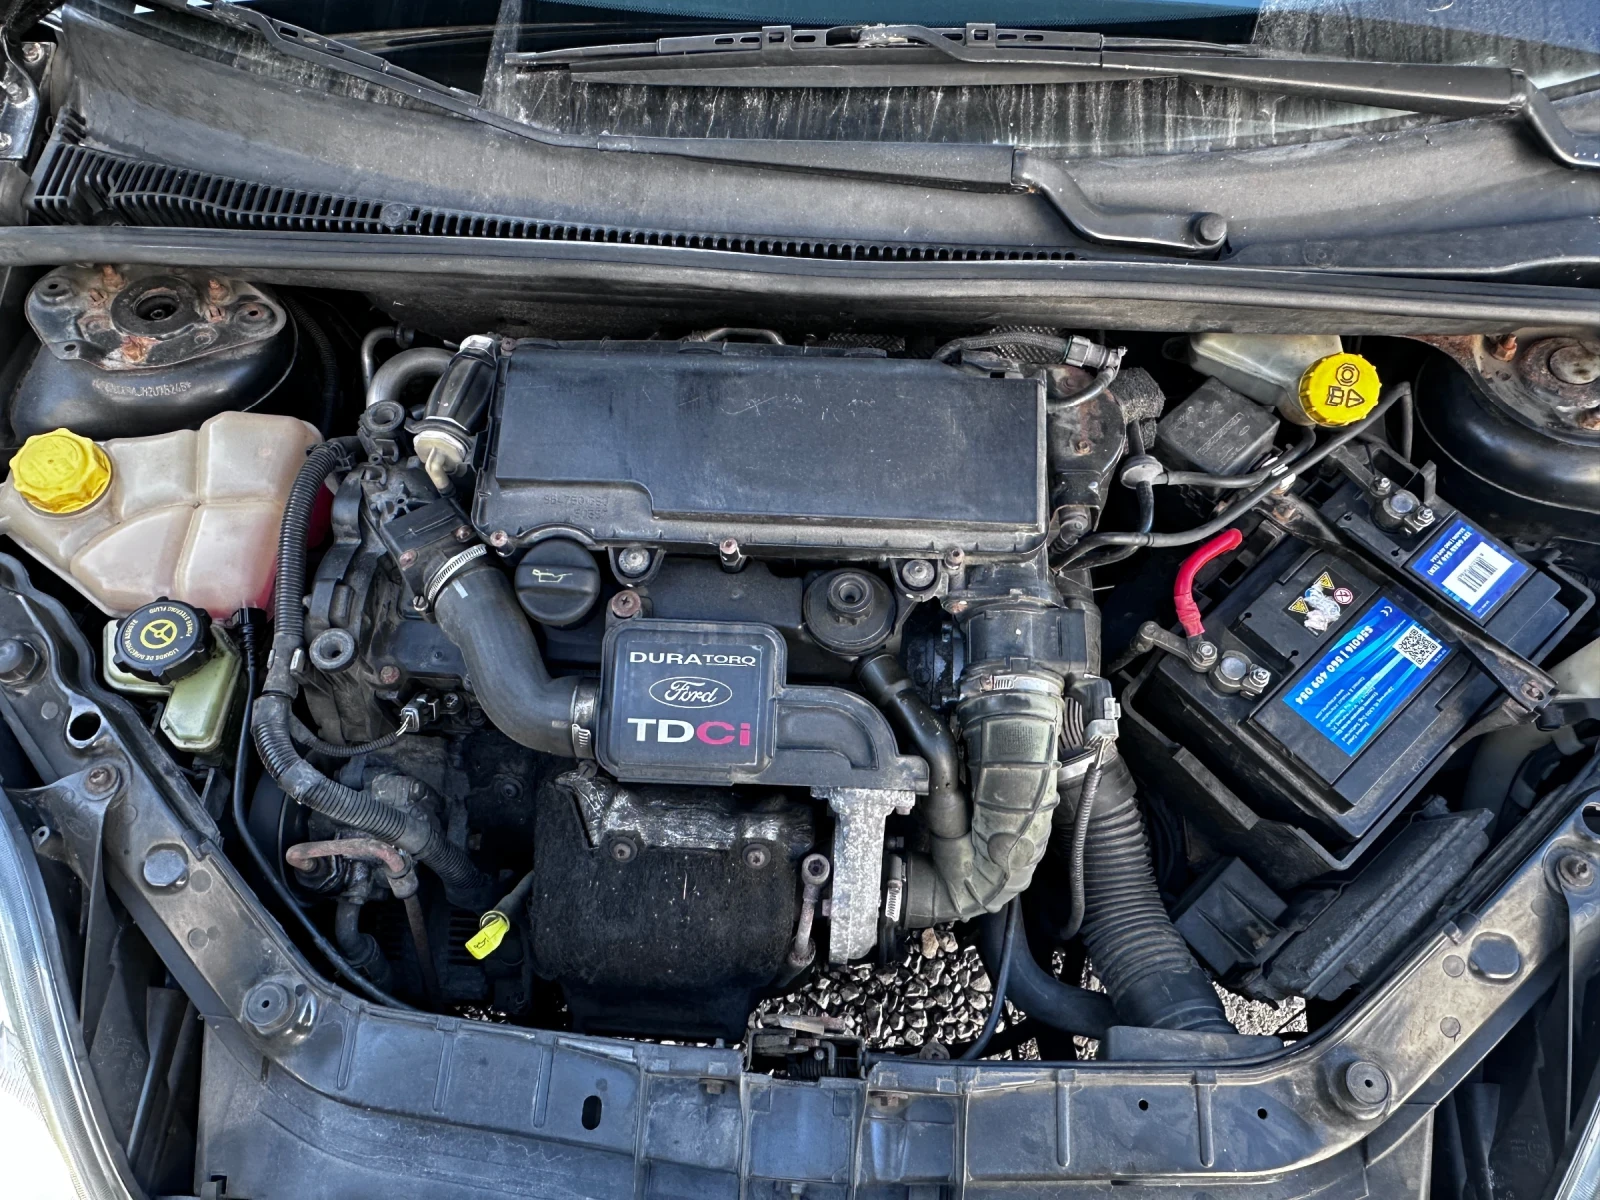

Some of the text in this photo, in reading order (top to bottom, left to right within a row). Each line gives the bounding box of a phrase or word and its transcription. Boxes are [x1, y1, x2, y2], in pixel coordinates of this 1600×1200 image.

[1344, 625, 1374, 654] S56016
[629, 651, 756, 667] DURATORQ
[1326, 655, 1344, 673] 560
[1310, 670, 1329, 689] 409
[664, 680, 719, 703] Ford
[1295, 687, 1313, 705] 054
[627, 717, 751, 746] TDCi
